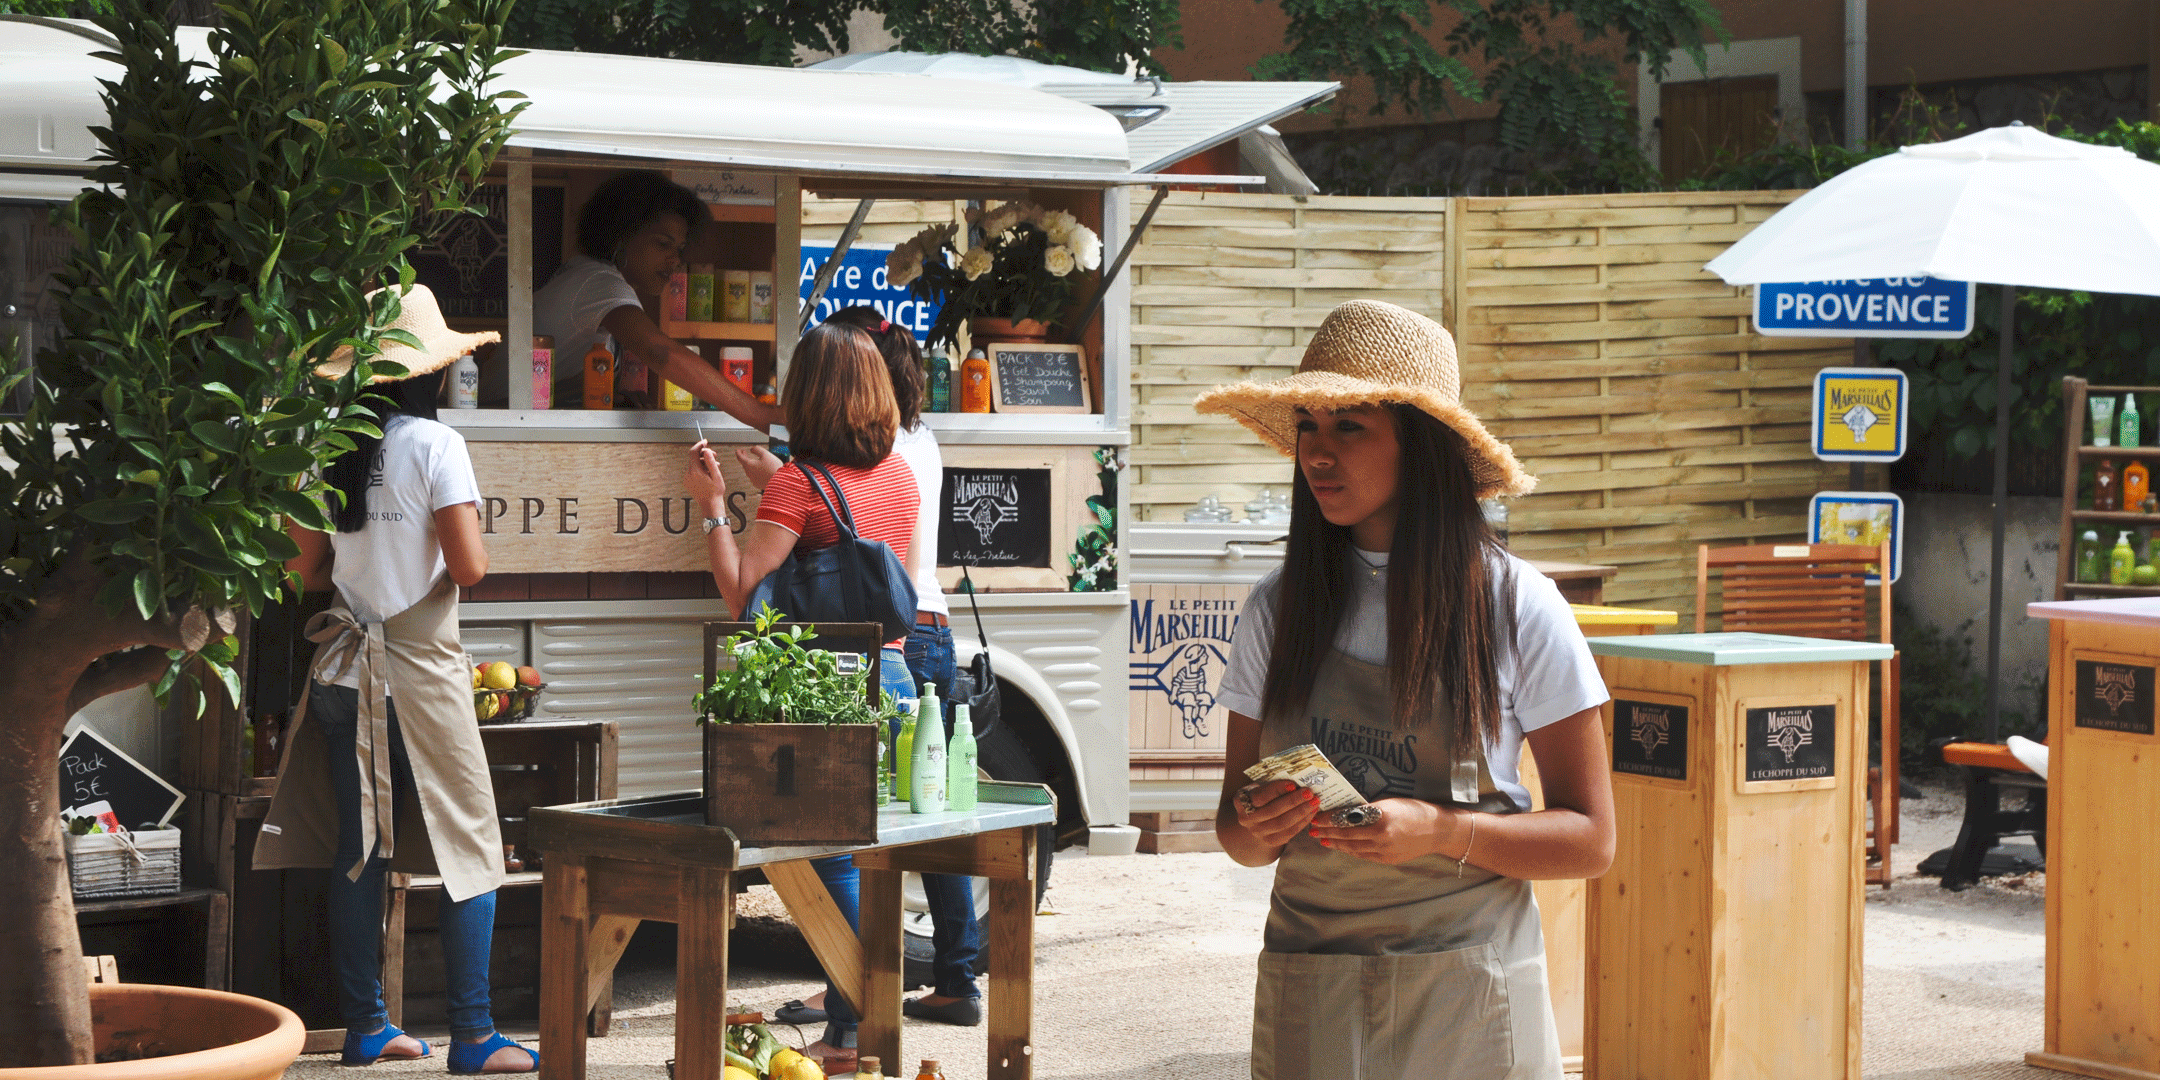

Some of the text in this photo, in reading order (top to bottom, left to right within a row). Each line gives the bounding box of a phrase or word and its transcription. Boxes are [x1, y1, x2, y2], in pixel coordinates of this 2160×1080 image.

[1775, 292, 1950, 323] PROVENCE
[997, 352, 1034, 365] PACK
[1830, 387, 1893, 412] MARSEILLAIS
[953, 475, 1019, 505] MARSEILLAIS
[381, 512, 403, 522] SUD
[478, 491, 764, 536] PPE DU S
[1169, 599, 1237, 611] LE PETIT
[1341, 722, 1394, 740] LE PETIT
[1767, 708, 1813, 734] MARSEILLAIS
[1311, 716, 1418, 775] MARSEILLAIS
[59, 752, 108, 776] Pack
